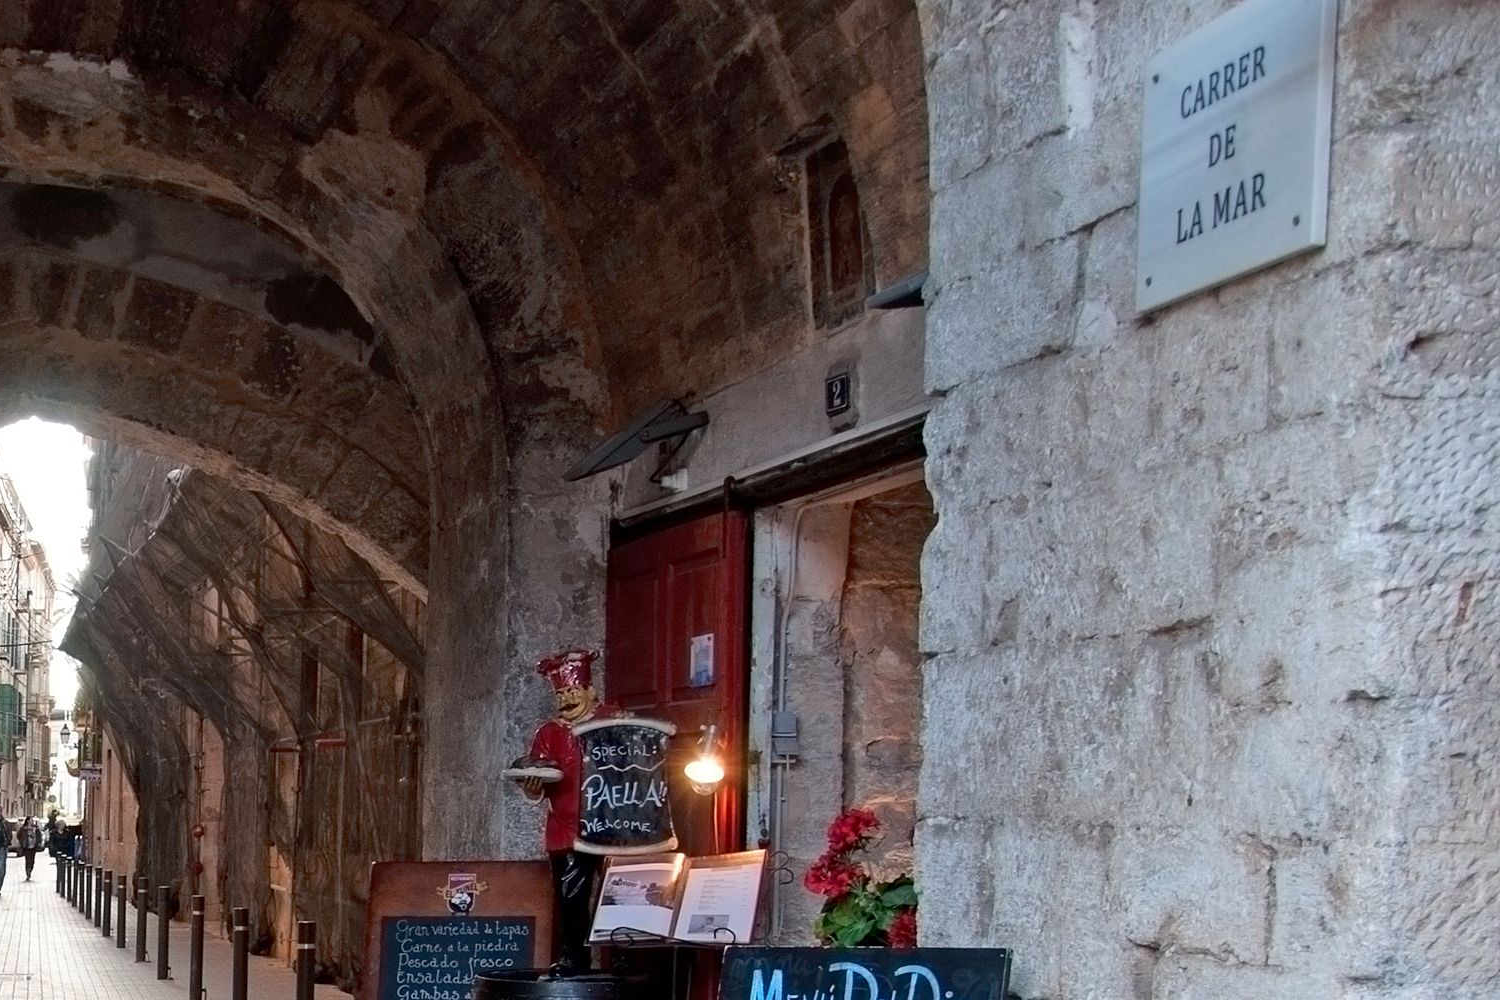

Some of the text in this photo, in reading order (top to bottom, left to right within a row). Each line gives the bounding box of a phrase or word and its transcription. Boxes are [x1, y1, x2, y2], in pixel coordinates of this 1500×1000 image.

[1180, 46, 1266, 119] CARRER
[1208, 124, 1236, 168] DE
[1176, 173, 1266, 244] LA MAR
[832, 380, 841, 406] 2
[581, 817, 651, 833] WELCOME
[396, 920, 529, 942] Gran variedad de tapas
[401, 939, 520, 958] Carne a la piedra
[398, 953, 514, 980] Pescado fresco
